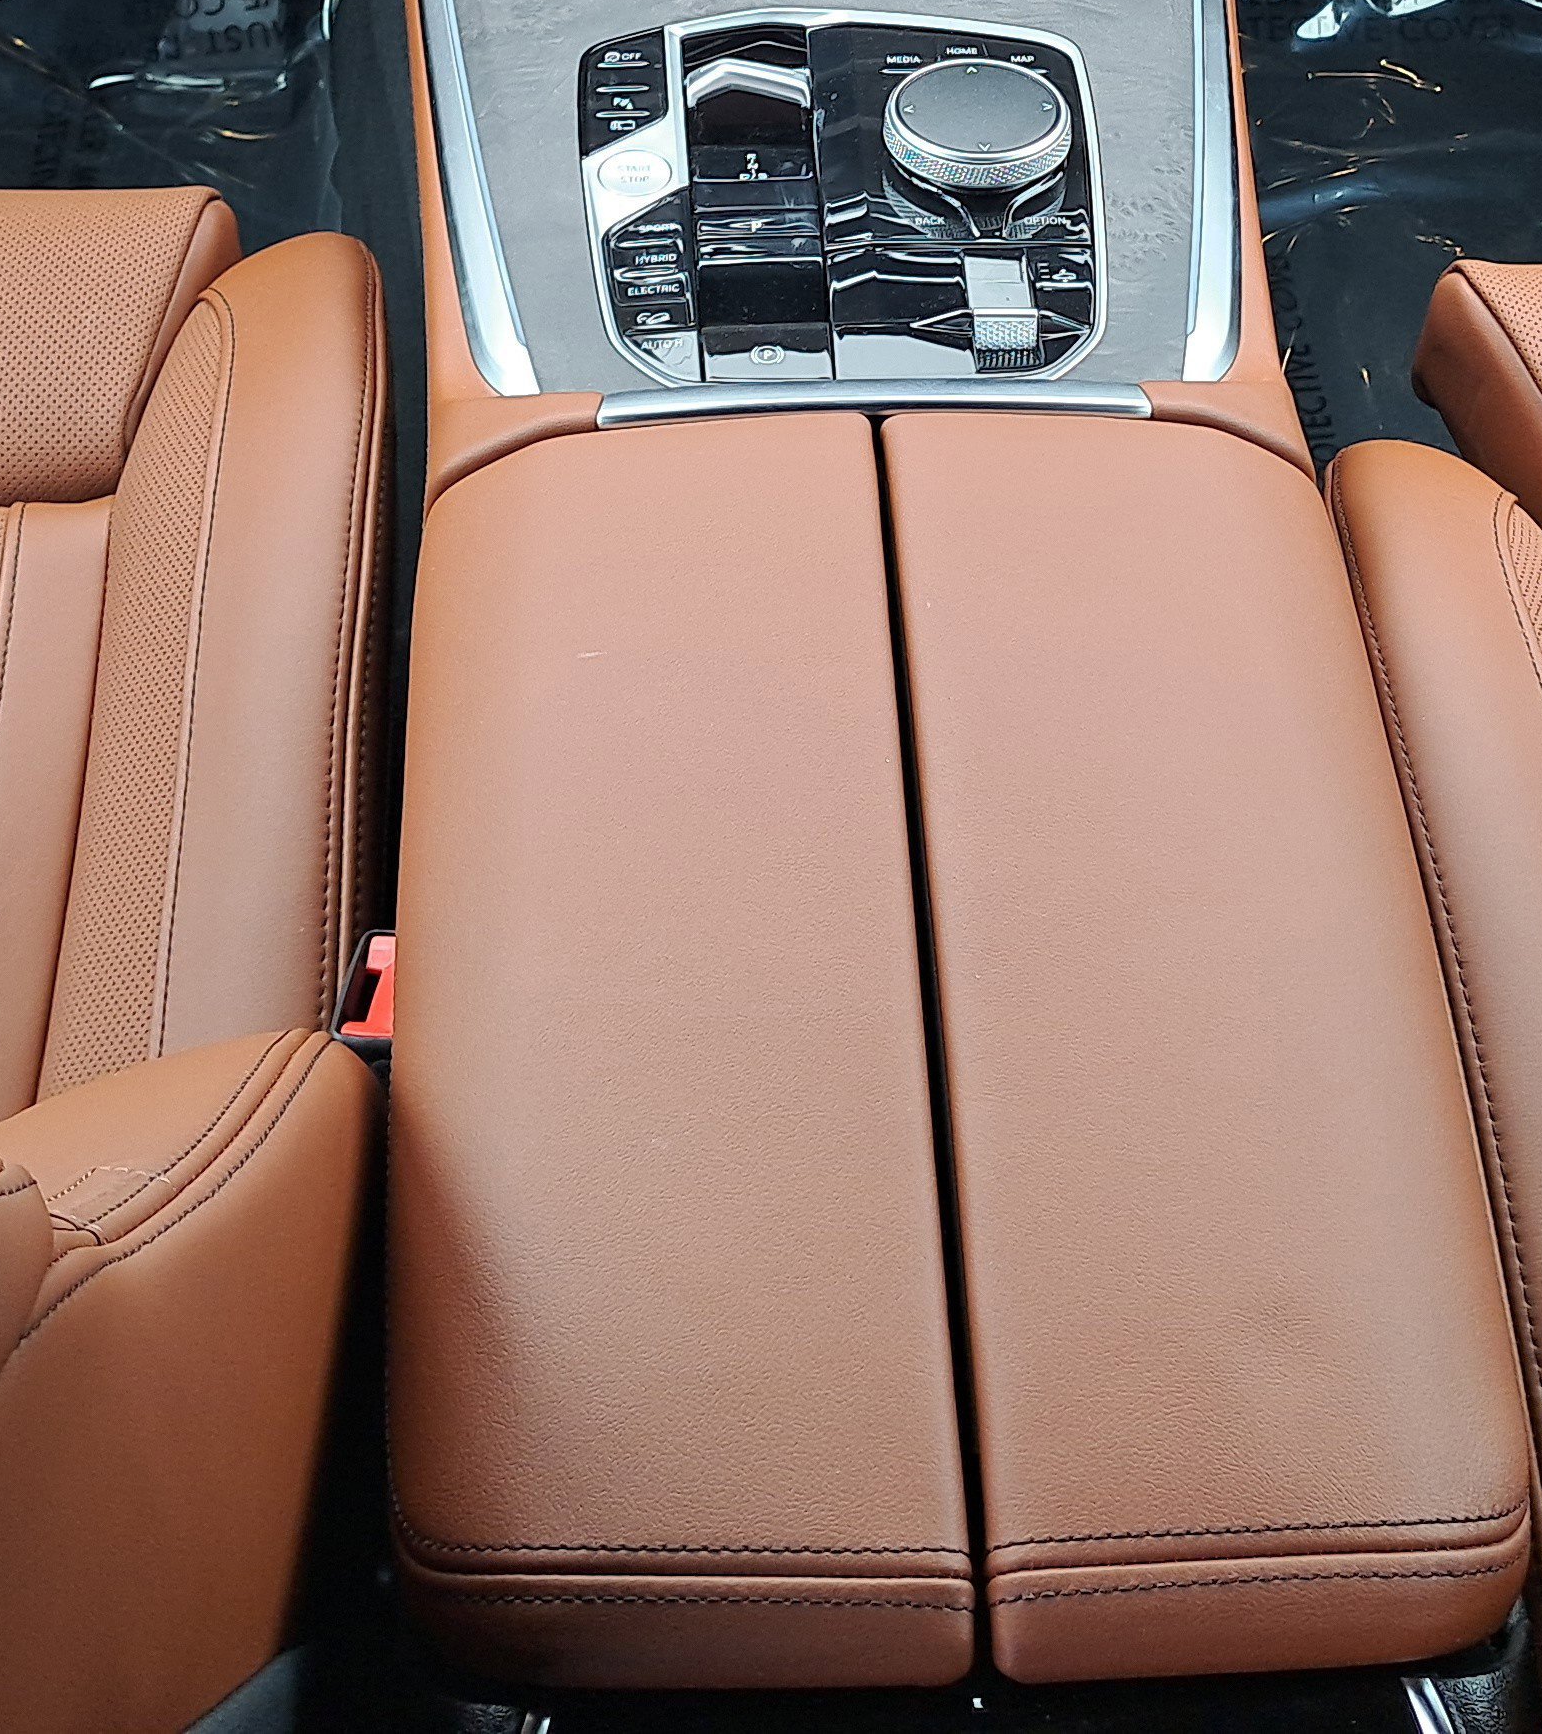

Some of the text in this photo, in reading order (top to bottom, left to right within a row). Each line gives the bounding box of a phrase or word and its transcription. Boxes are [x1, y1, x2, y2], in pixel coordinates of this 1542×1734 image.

[946, 46, 978, 56] HOME
[886, 54, 921, 64] MEDIA
[1010, 54, 1035, 64] MAP
[915, 216, 946, 226] BACK
[635, 252, 678, 266] HYBRID
[627, 283, 680, 297] ELECTRIC
